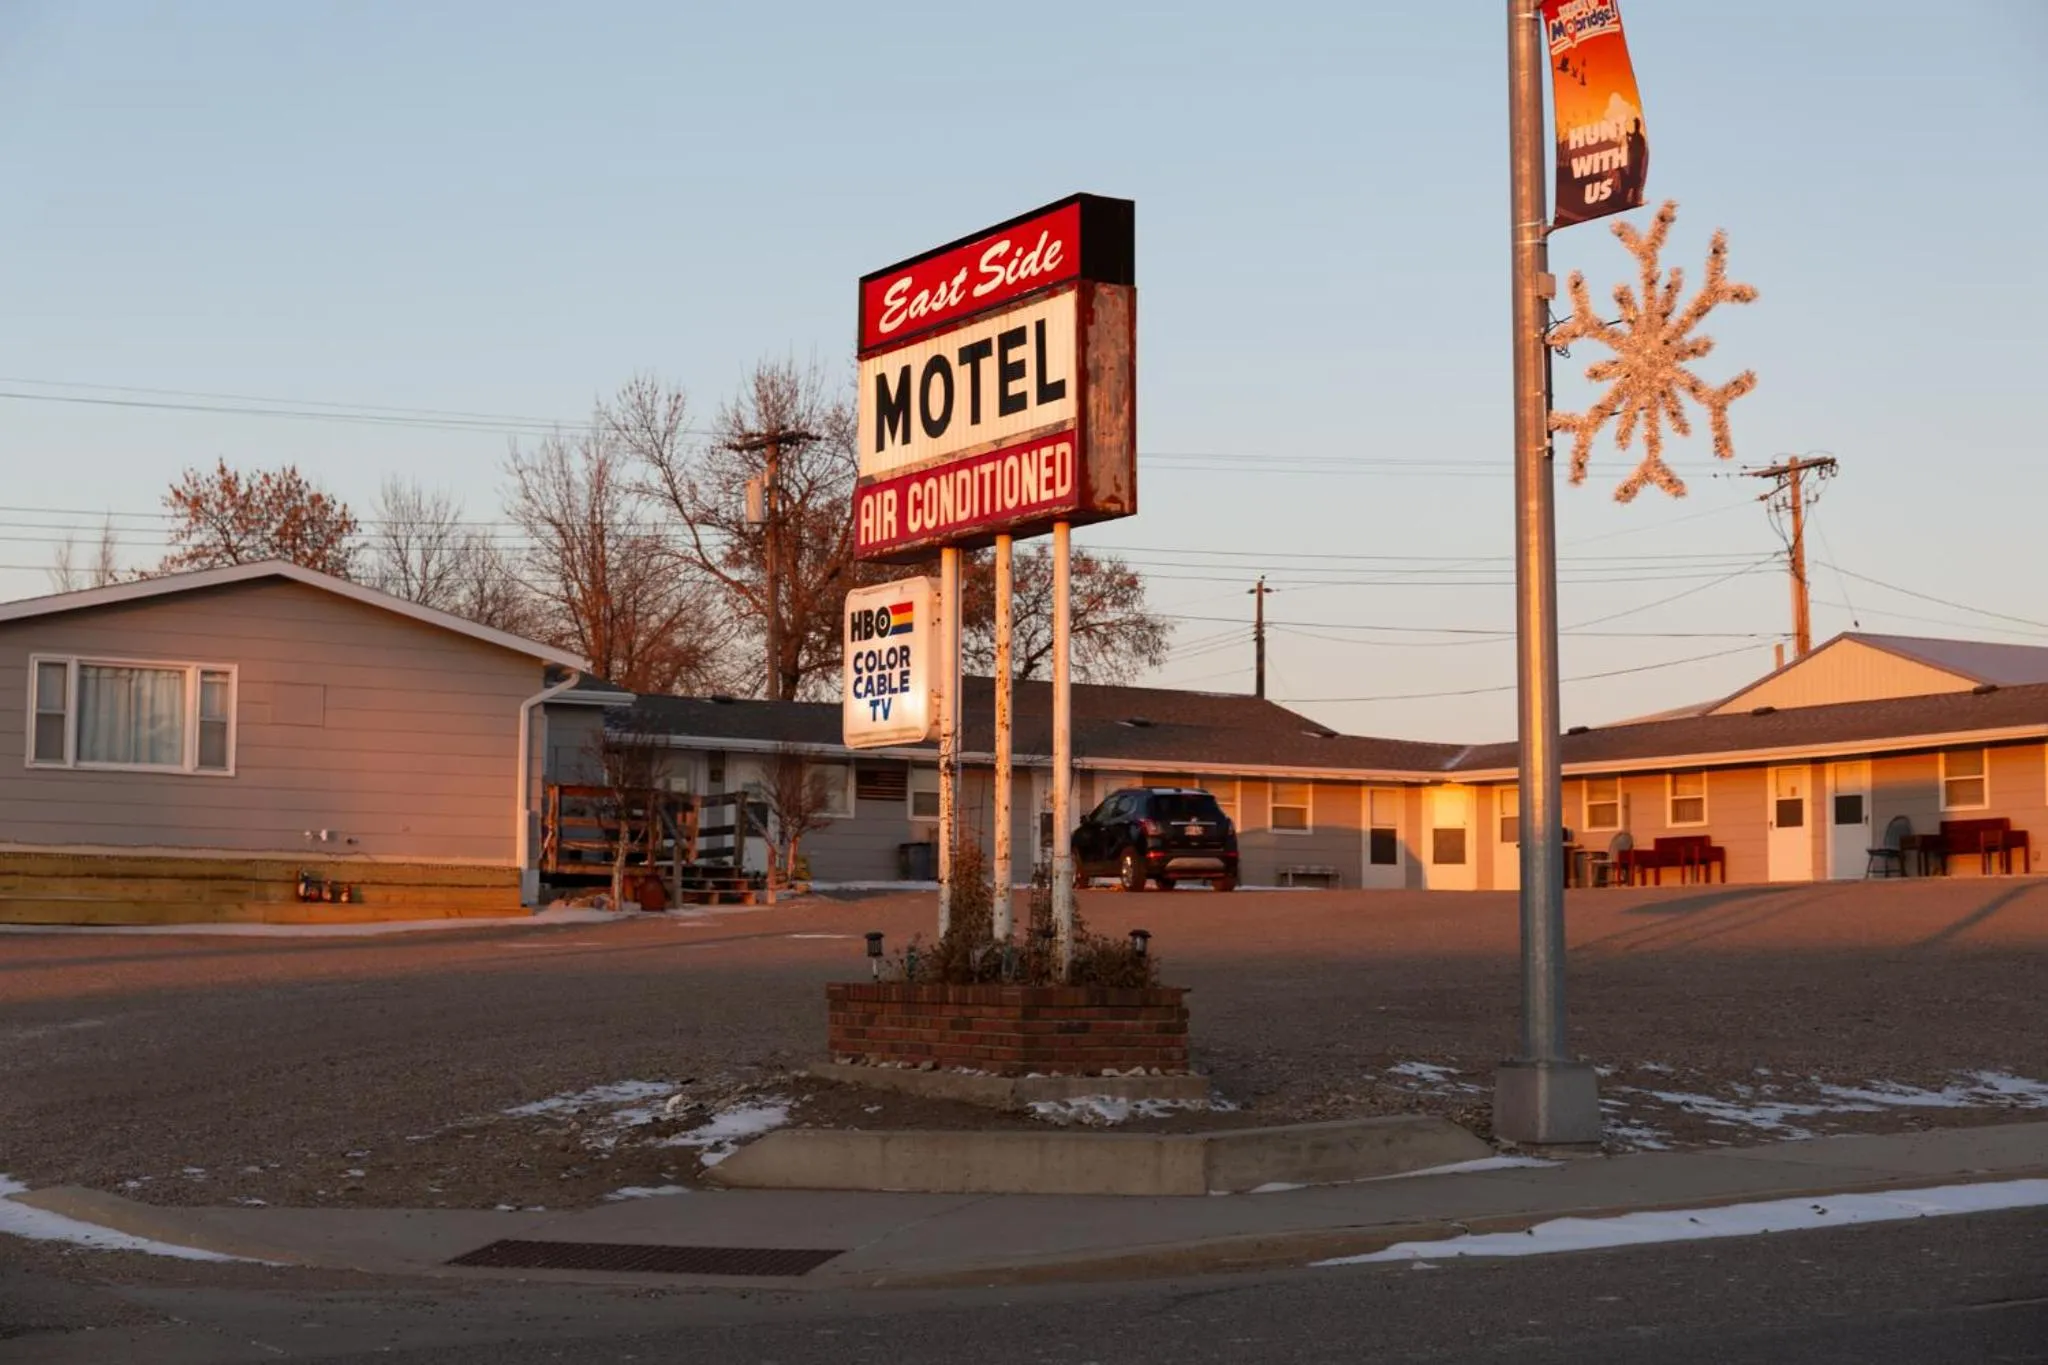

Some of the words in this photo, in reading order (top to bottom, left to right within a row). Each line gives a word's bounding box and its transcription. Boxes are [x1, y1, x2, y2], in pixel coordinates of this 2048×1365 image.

[1568, 117, 1628, 150] HUNT
[1571, 143, 1629, 179] WITH
[1584, 178, 1614, 204] US
[878, 267, 968, 334] East
[973, 230, 1064, 298] Side
[875, 317, 1066, 453] MOTEL
[860, 489, 897, 545] AIR
[907, 442, 1073, 533] CONDITIONED
[851, 606, 891, 642] HBO
[853, 645, 911, 675] COLOR
[853, 670, 911, 699] CABLE
[869, 697, 892, 722] TV
